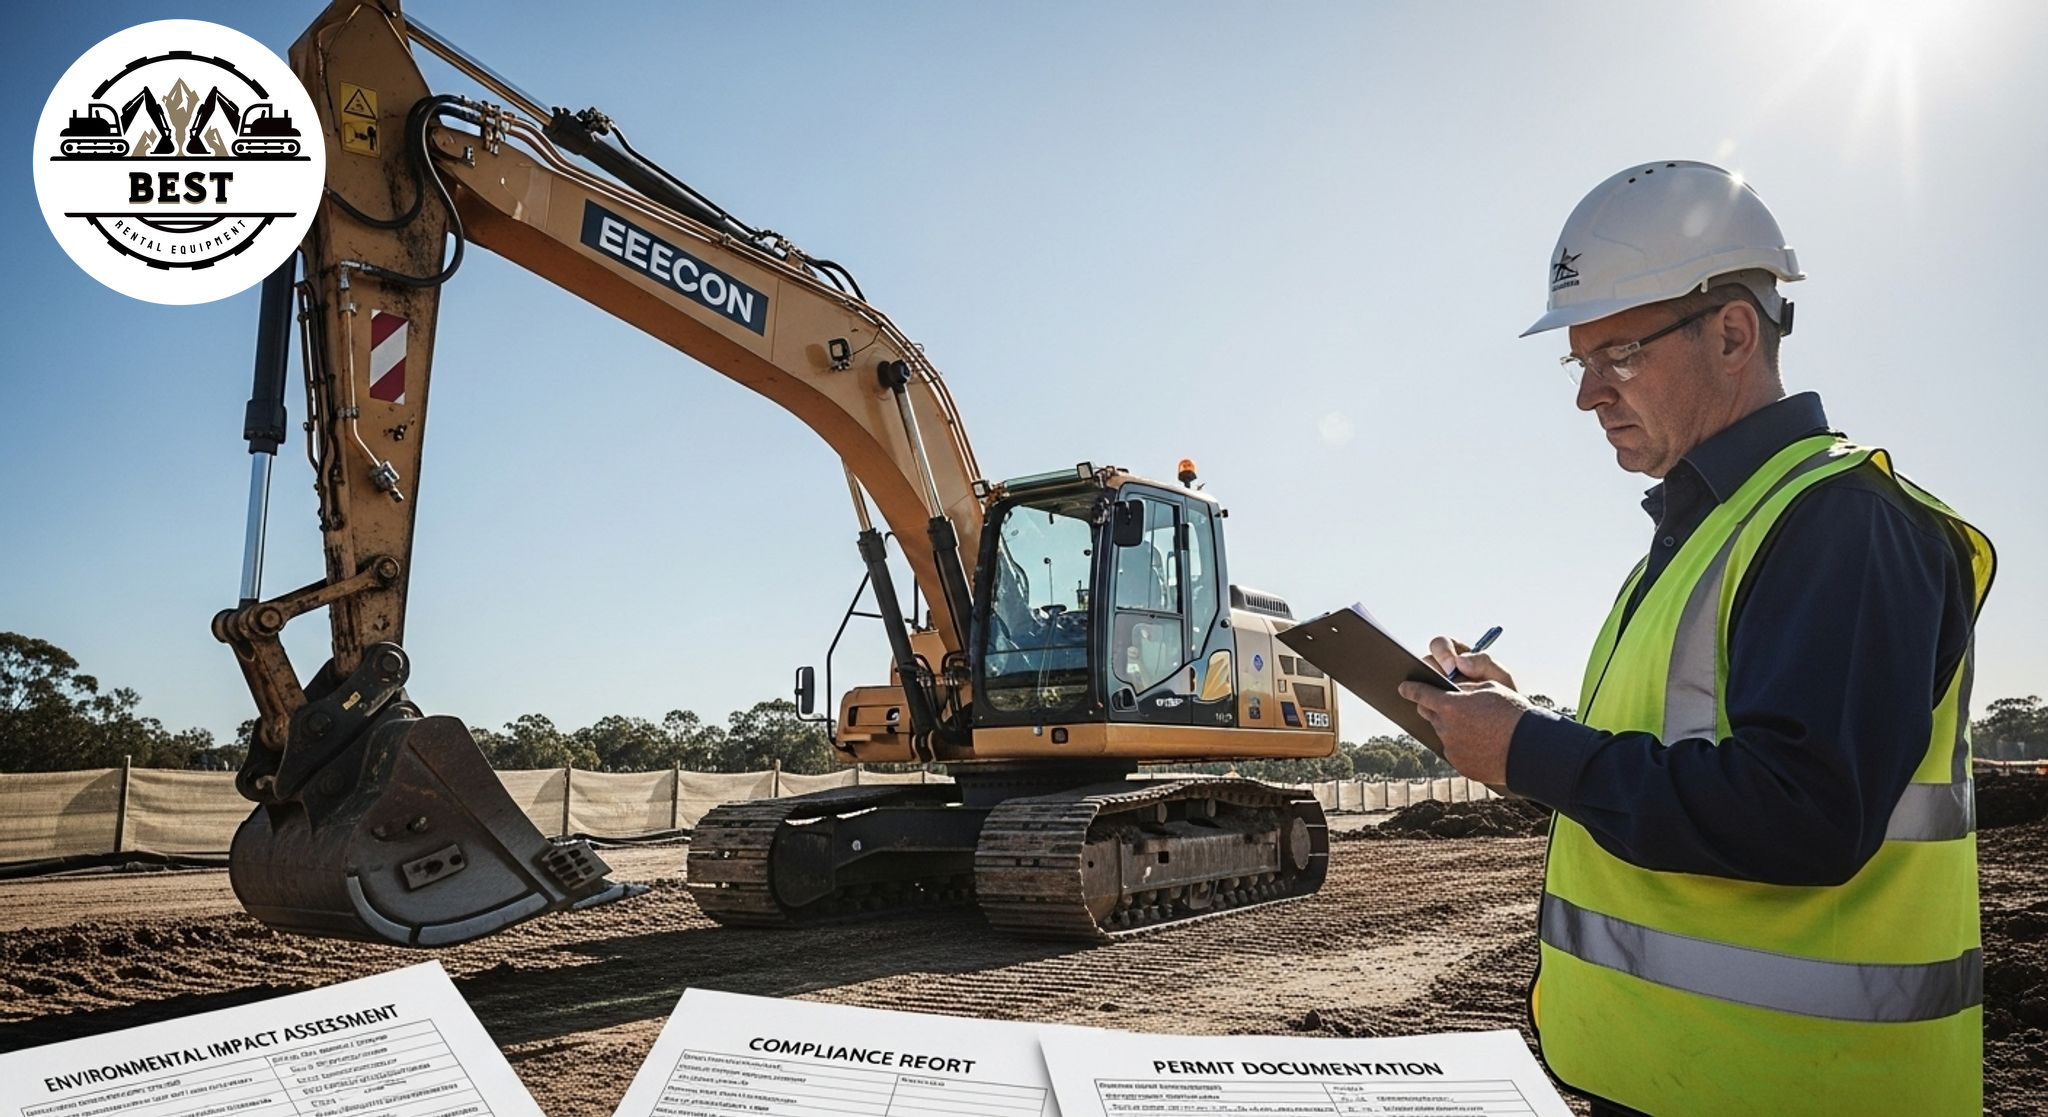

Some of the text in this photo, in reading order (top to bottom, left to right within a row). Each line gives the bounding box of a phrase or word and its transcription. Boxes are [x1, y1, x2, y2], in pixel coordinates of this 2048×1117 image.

[599, 216, 754, 323] EEECON
[43, 1043, 208, 1093] ENVIRONMENTAL
[207, 1031, 279, 1059] IMPACT
[749, 1037, 895, 1067] COMPLIANCE
[899, 1053, 976, 1074] REORT
[1153, 1060, 1444, 1077] PERMIT DOCUMENTATION
